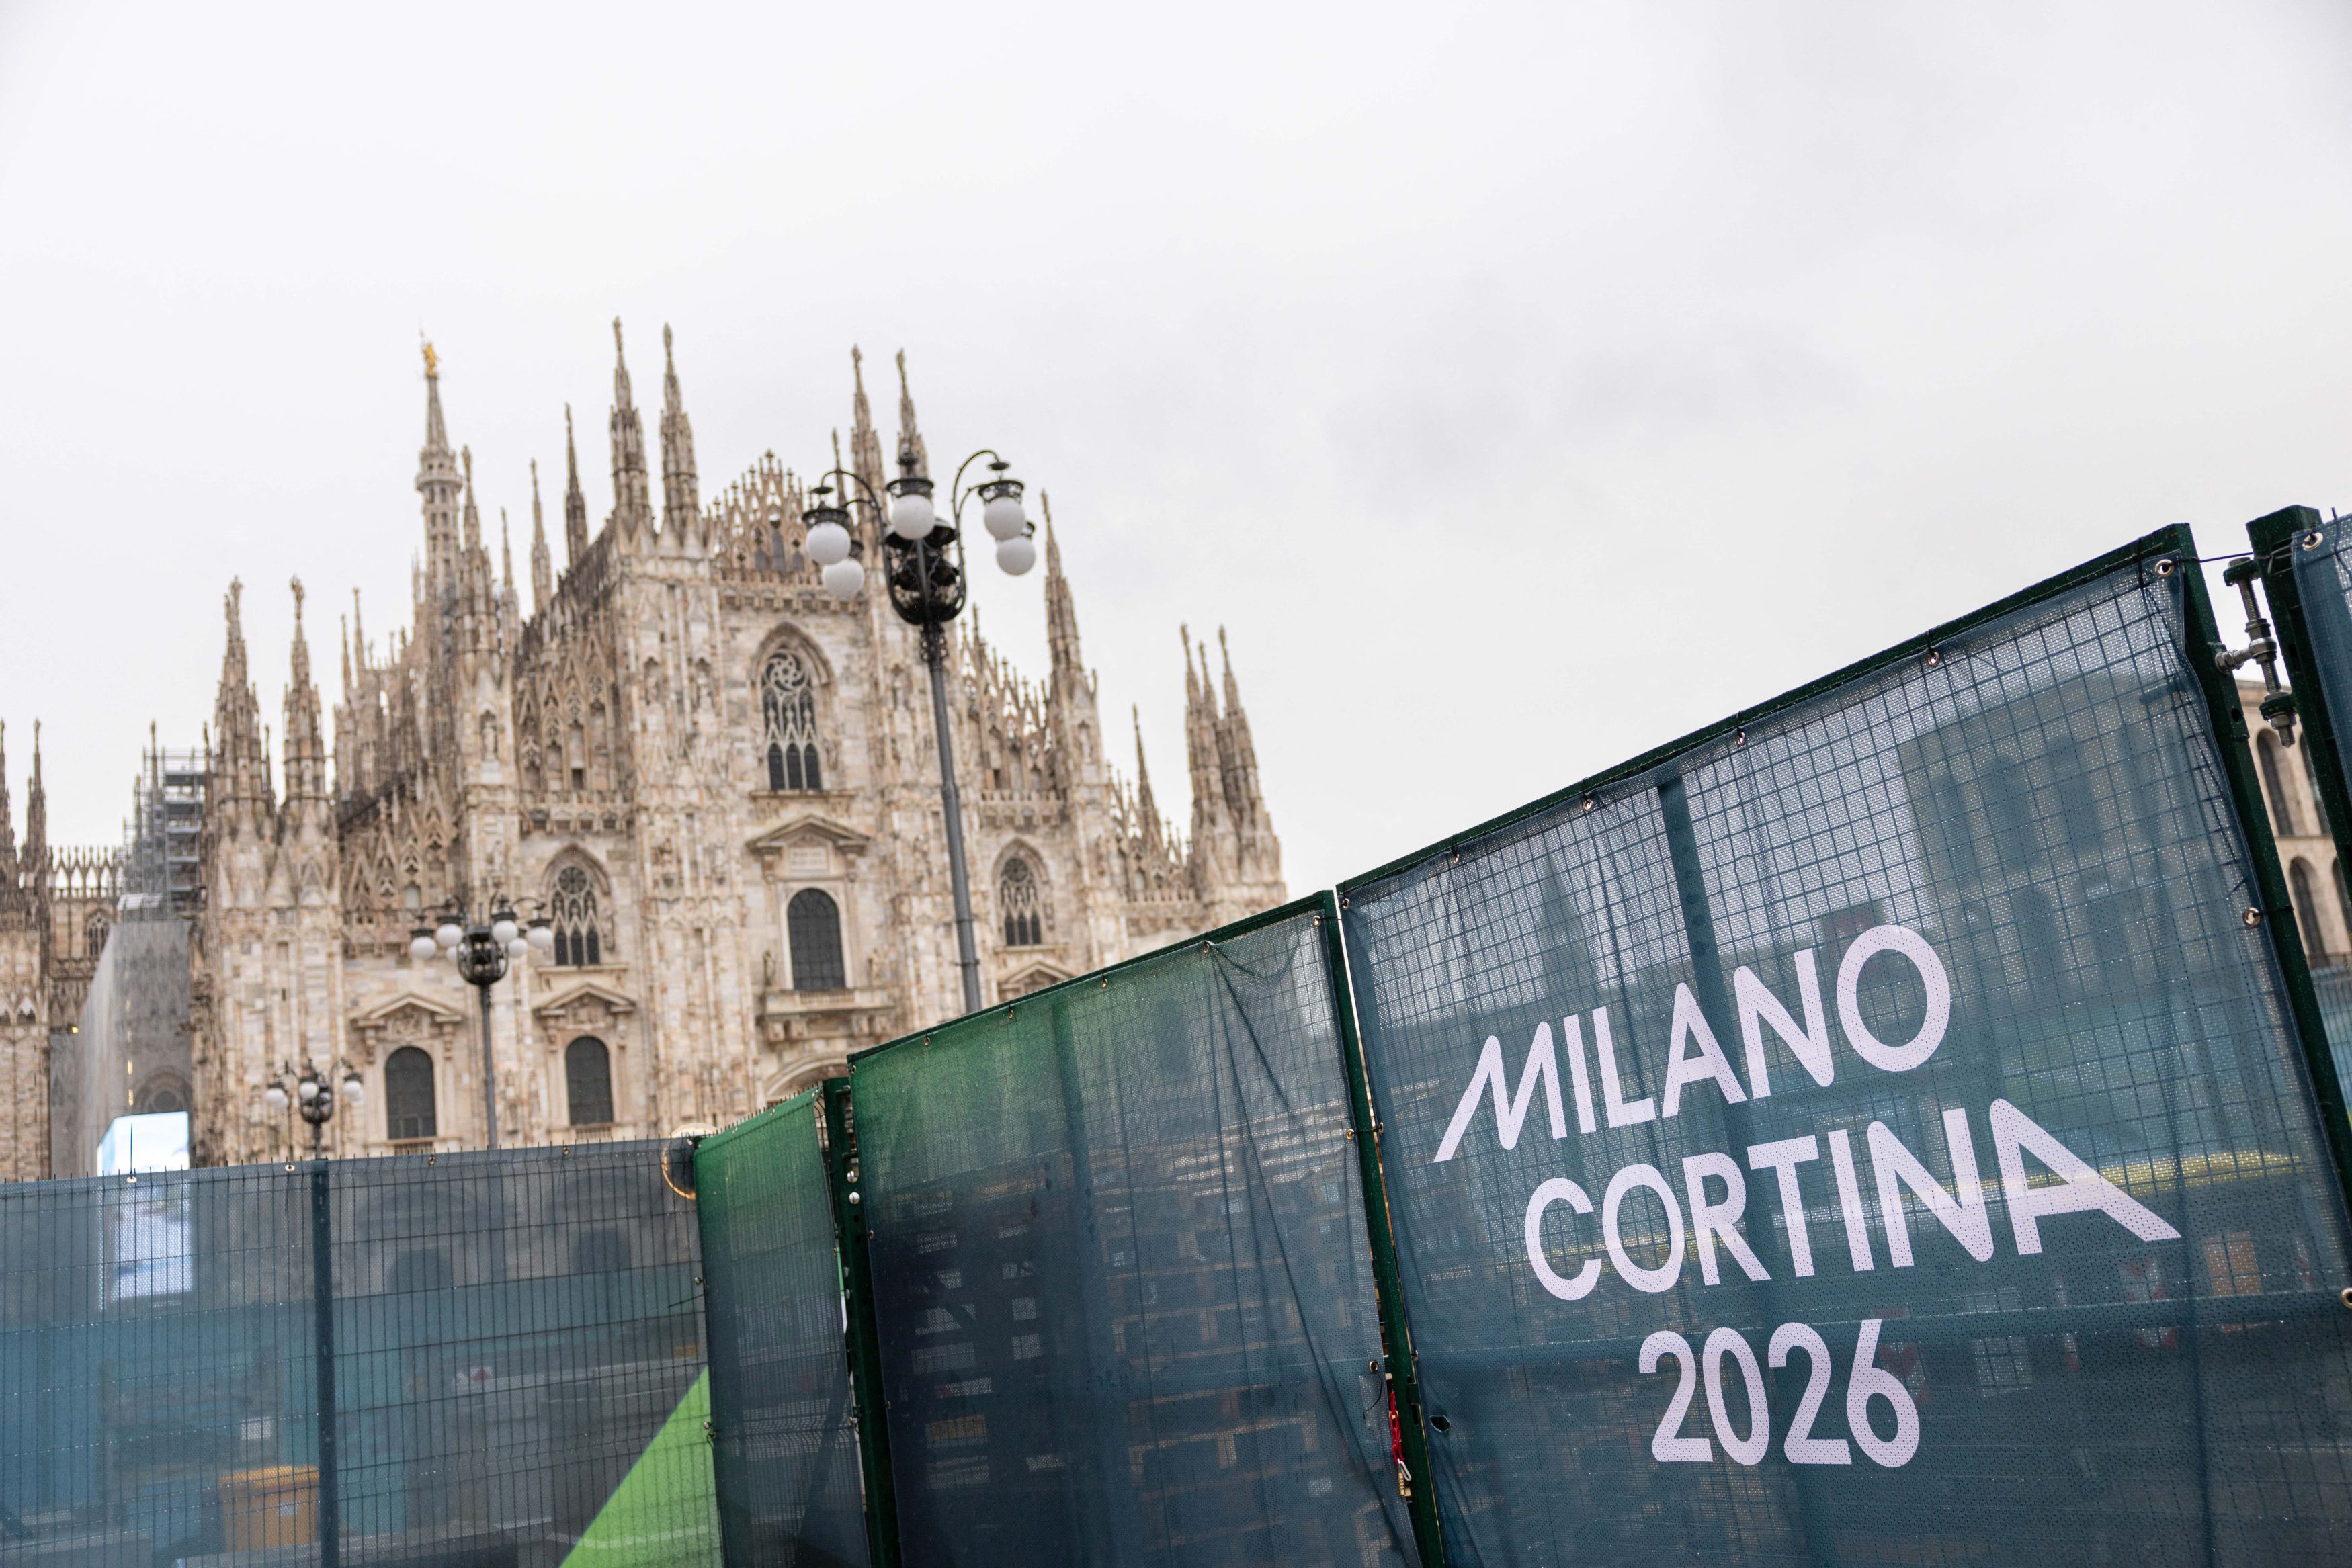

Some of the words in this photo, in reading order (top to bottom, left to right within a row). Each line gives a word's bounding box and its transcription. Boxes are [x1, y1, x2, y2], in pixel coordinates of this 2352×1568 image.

[1434, 925, 1951, 1162] MILANO
[1524, 1098, 2182, 1301] CORTINA
[1638, 1319, 1920, 1467] 2026
